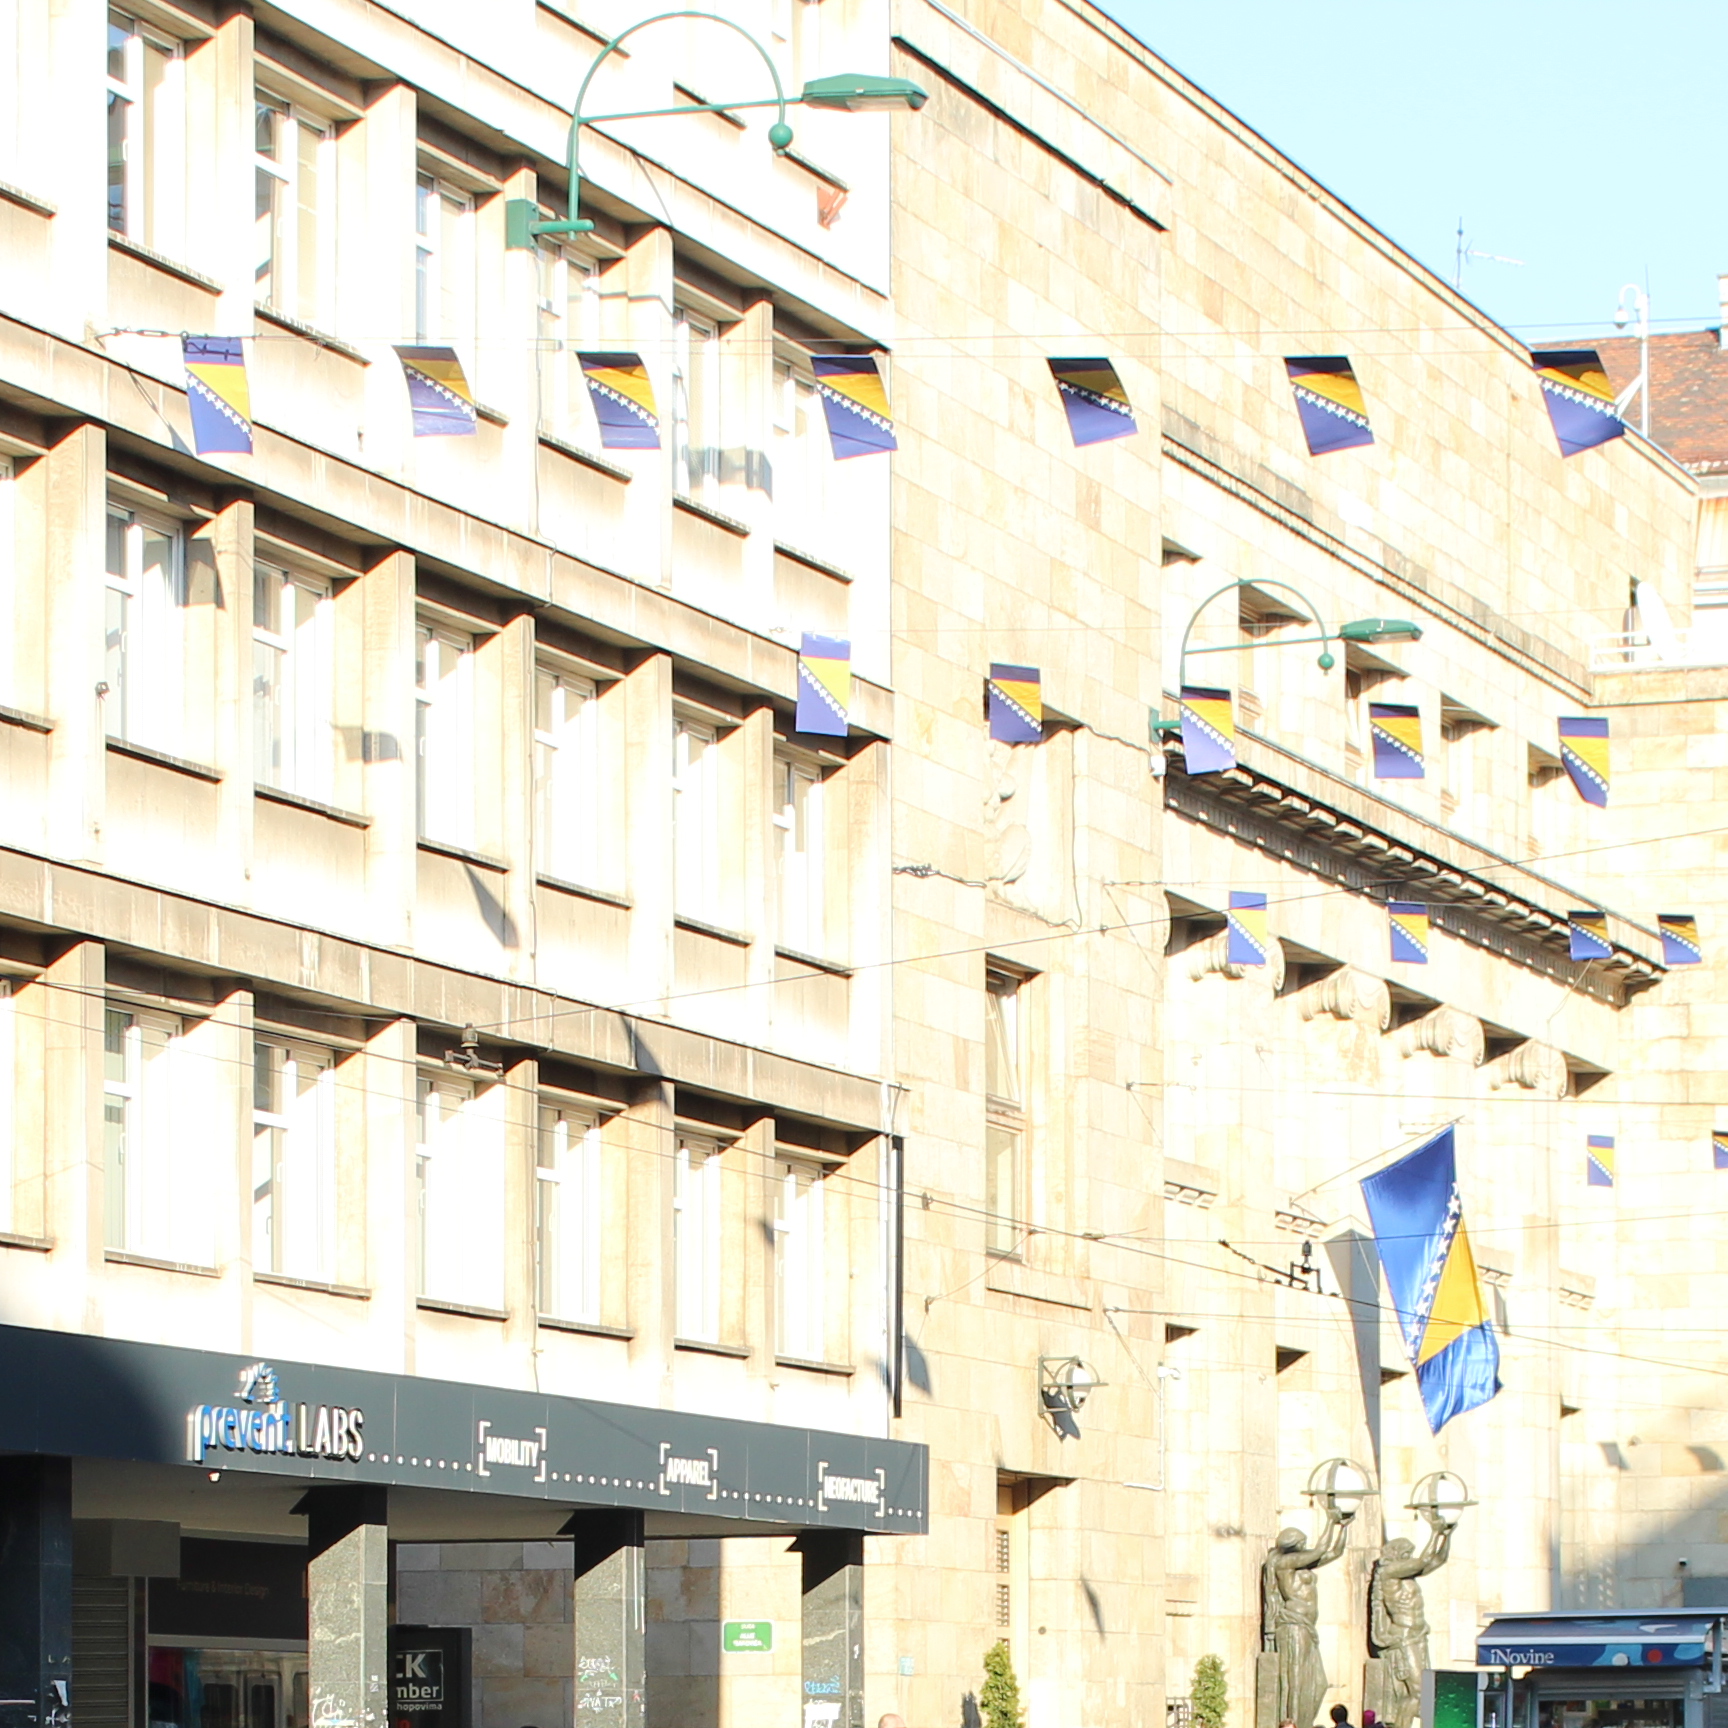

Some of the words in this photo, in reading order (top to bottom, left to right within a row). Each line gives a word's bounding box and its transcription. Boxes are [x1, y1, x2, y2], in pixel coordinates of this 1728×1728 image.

[186, 1401, 291, 1463] prevent
[297, 1402, 365, 1461] LABS
[485, 1435, 539, 1467] MOBILITY
[666, 1457, 712, 1486] APPAREL
[823, 1475, 879, 1504] NEOFACTURE
[1490, 1649, 1555, 1665] iNovine
